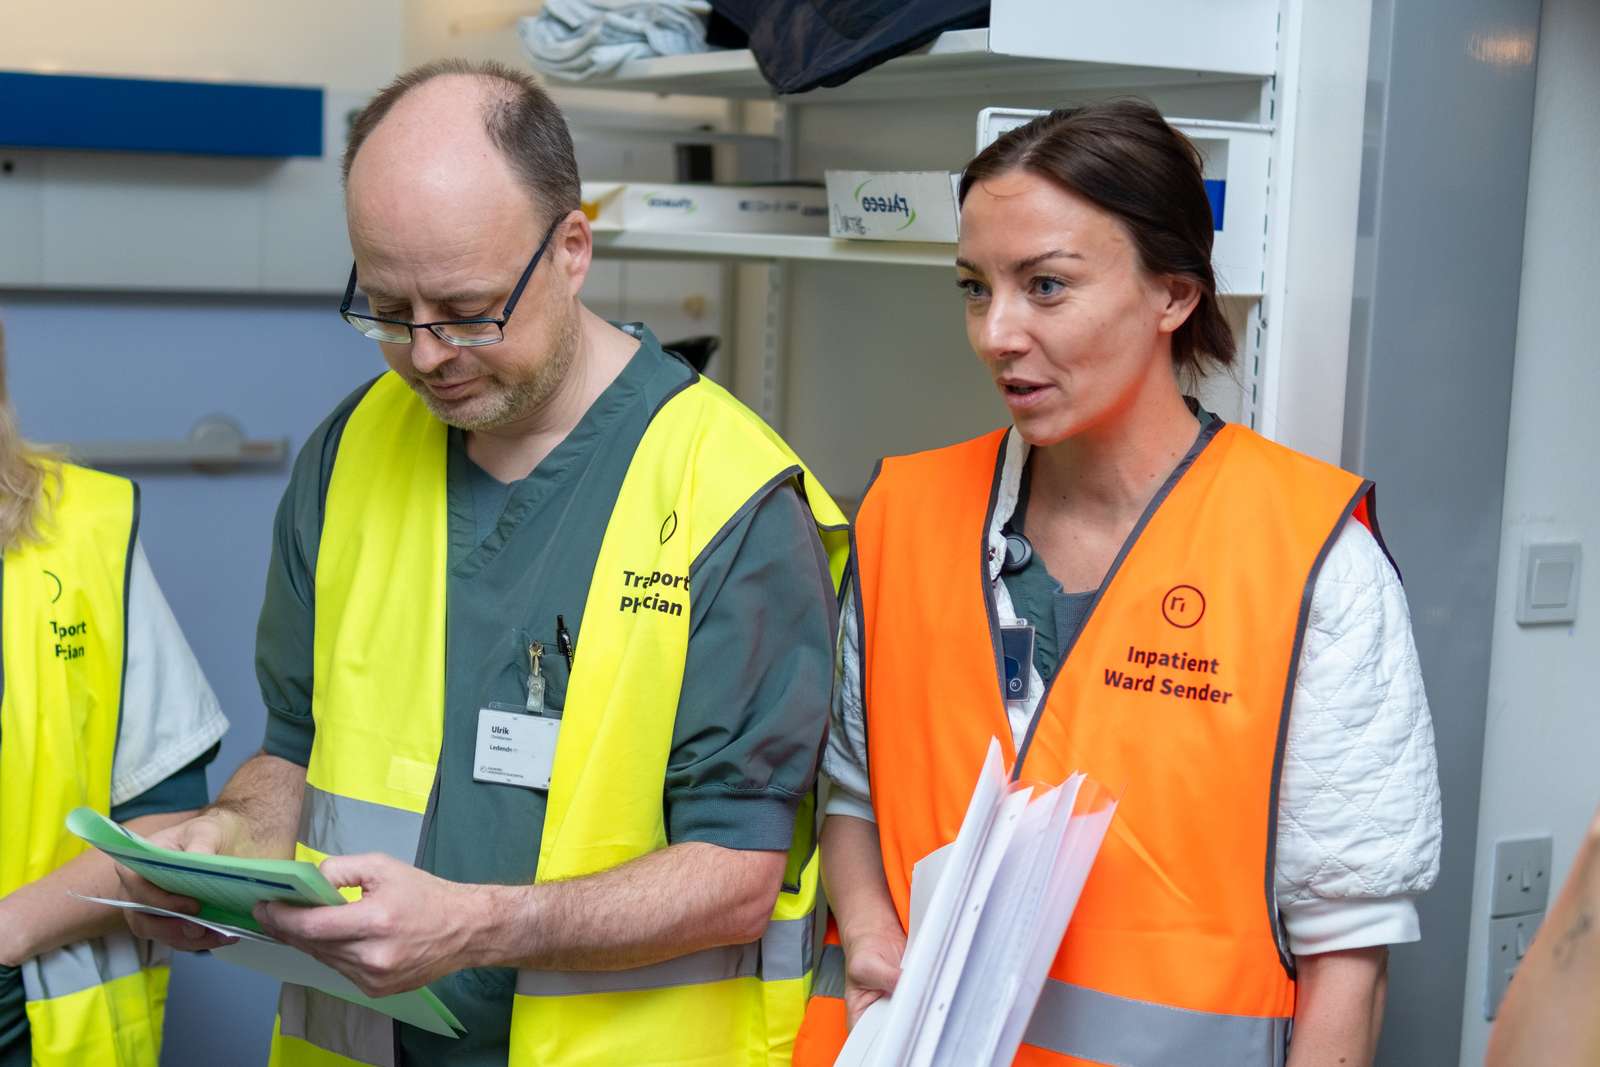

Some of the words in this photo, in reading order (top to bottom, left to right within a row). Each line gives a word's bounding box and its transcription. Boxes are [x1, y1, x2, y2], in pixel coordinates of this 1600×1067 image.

[1127, 646, 1220, 674] Inpatient
[1104, 668, 1156, 692] Ward
[1160, 678, 1233, 704] Sender
[491, 726, 510, 735] Ulrik
